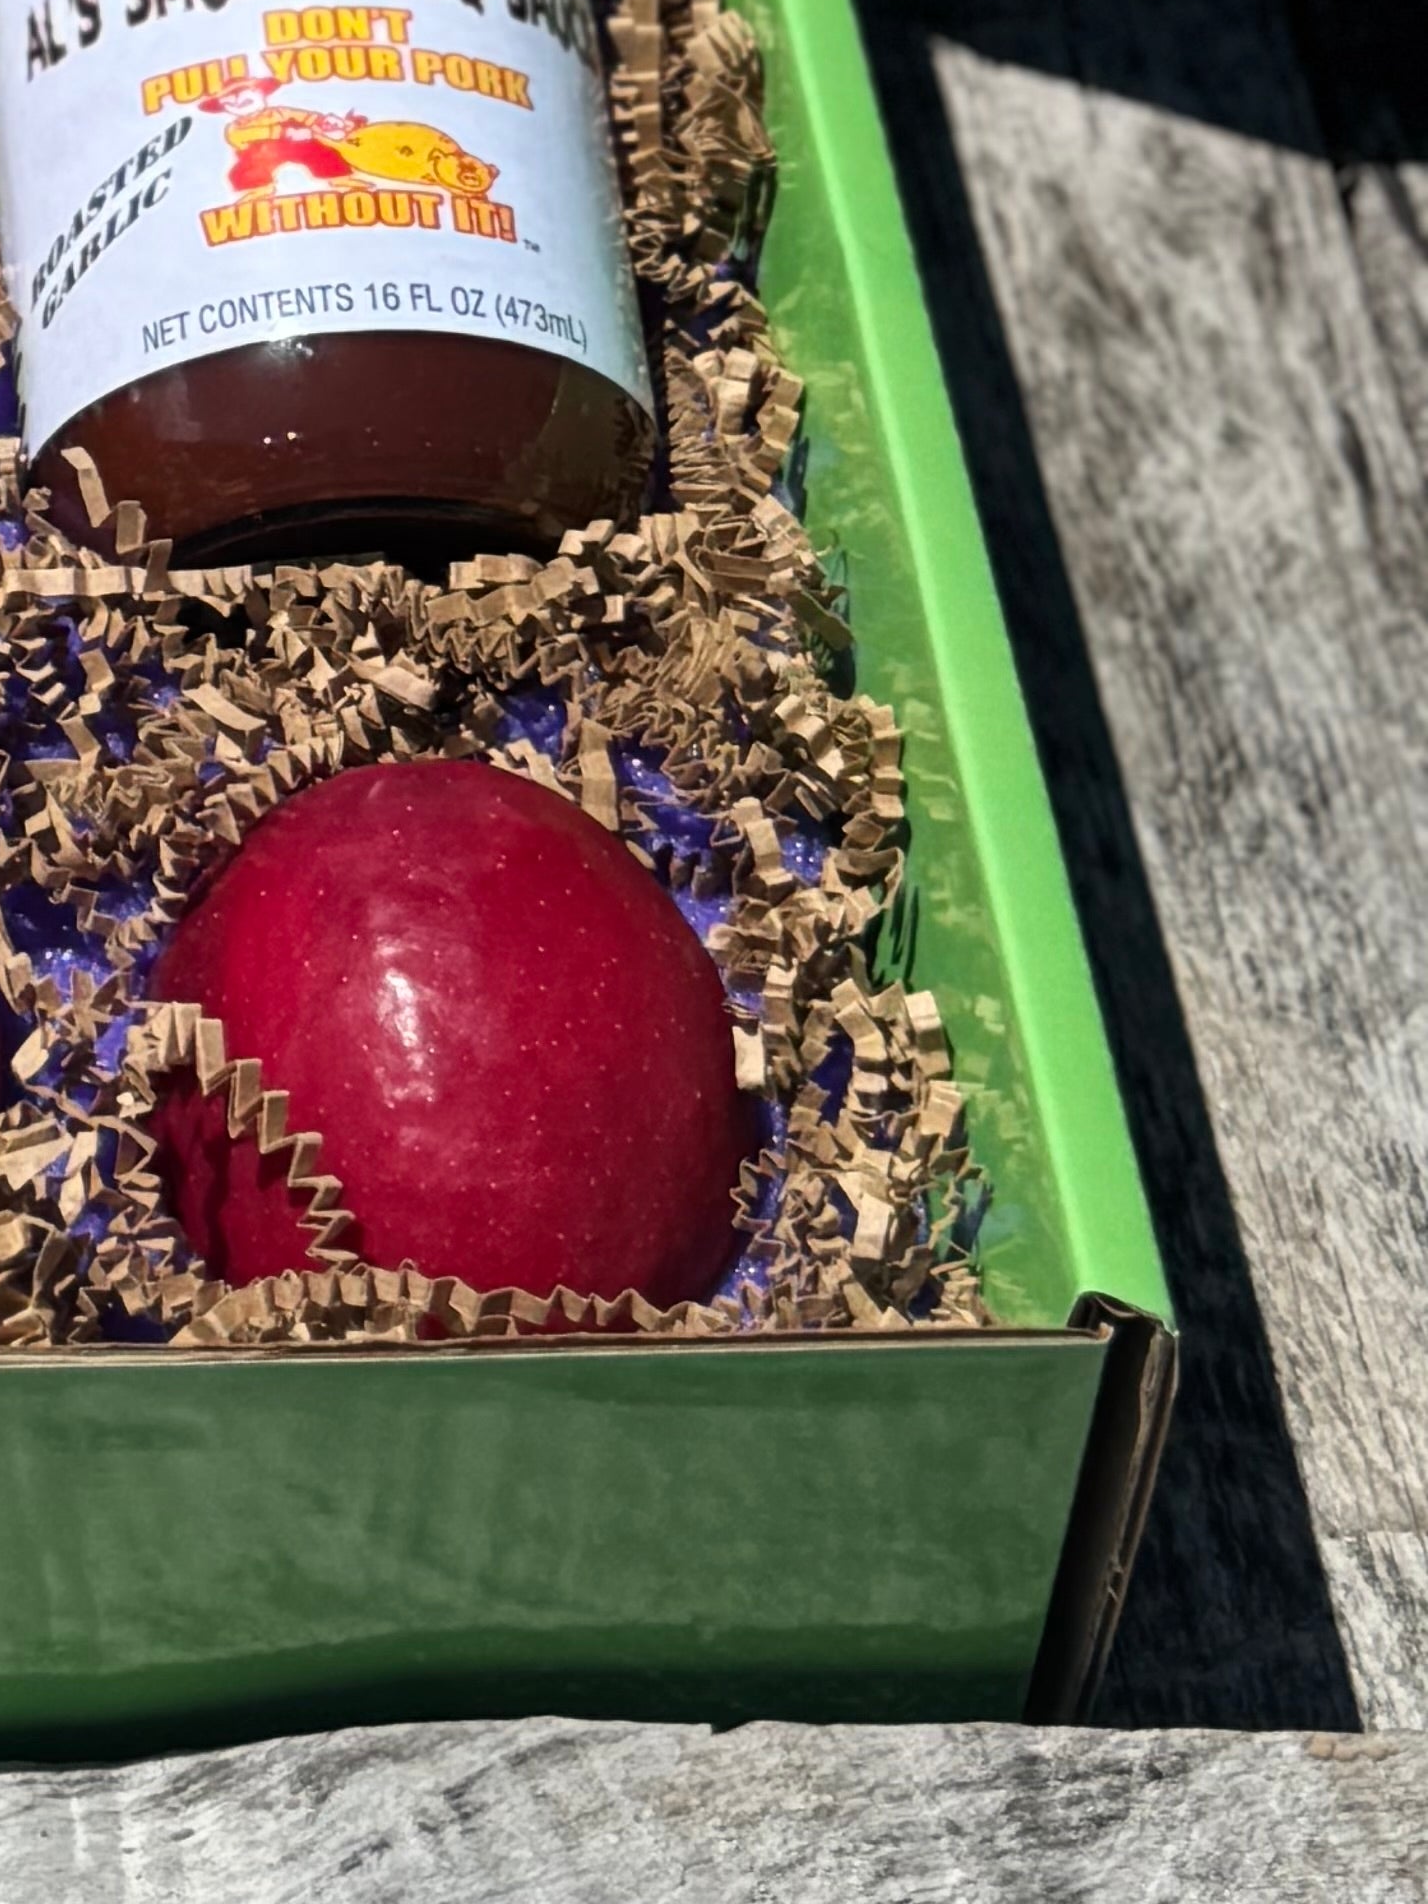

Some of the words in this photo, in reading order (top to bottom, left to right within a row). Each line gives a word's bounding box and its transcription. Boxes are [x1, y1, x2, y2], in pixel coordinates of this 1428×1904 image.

[262, 6, 413, 46] DON'T
[260, 44, 405, 84] YOUR
[410, 47, 535, 111] PORK
[30, 115, 193, 313] ROASTED
[41, 166, 173, 330] GARLIC
[199, 188, 444, 248] WITHOUT
[450, 195, 518, 244] IT!
[142, 311, 191, 354] NET
[198, 283, 354, 335] CONTENTS
[363, 282, 401, 312] 16
[408, 283, 443, 313] FL
[450, 285, 487, 319] OZ
[495, 293, 588, 354] (473mL)
